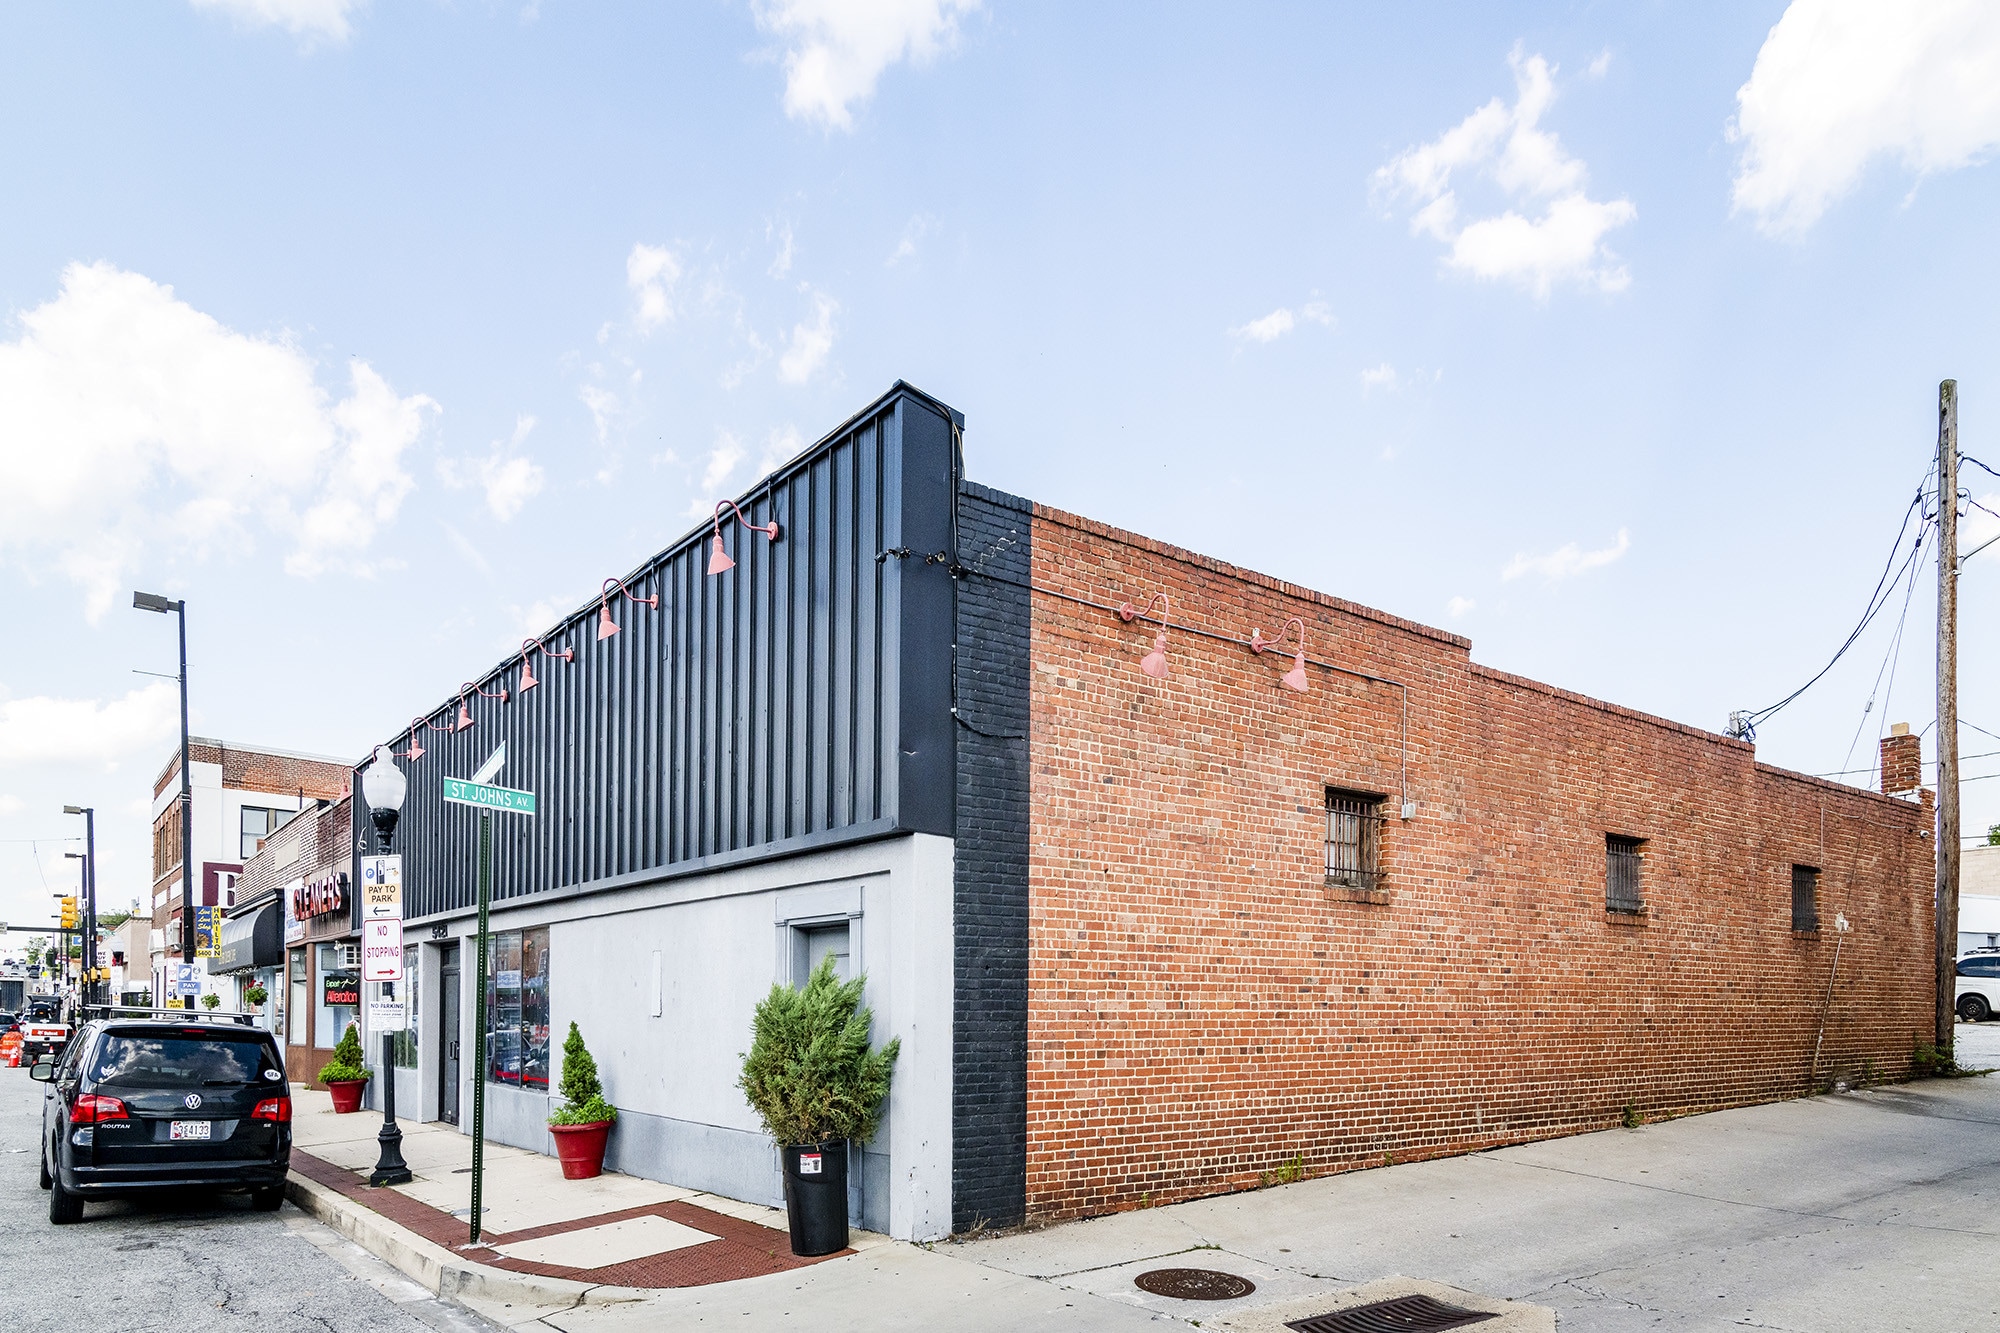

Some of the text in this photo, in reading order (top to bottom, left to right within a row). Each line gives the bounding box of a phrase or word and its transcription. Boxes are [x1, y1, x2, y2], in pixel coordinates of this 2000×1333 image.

[451, 782, 528, 807] ST. JOHNS AV.
[385, 885, 396, 893] TO
[294, 872, 341, 922] CLEANERS
[377, 925, 388, 936] NO
[367, 946, 399, 958] STOPPING
